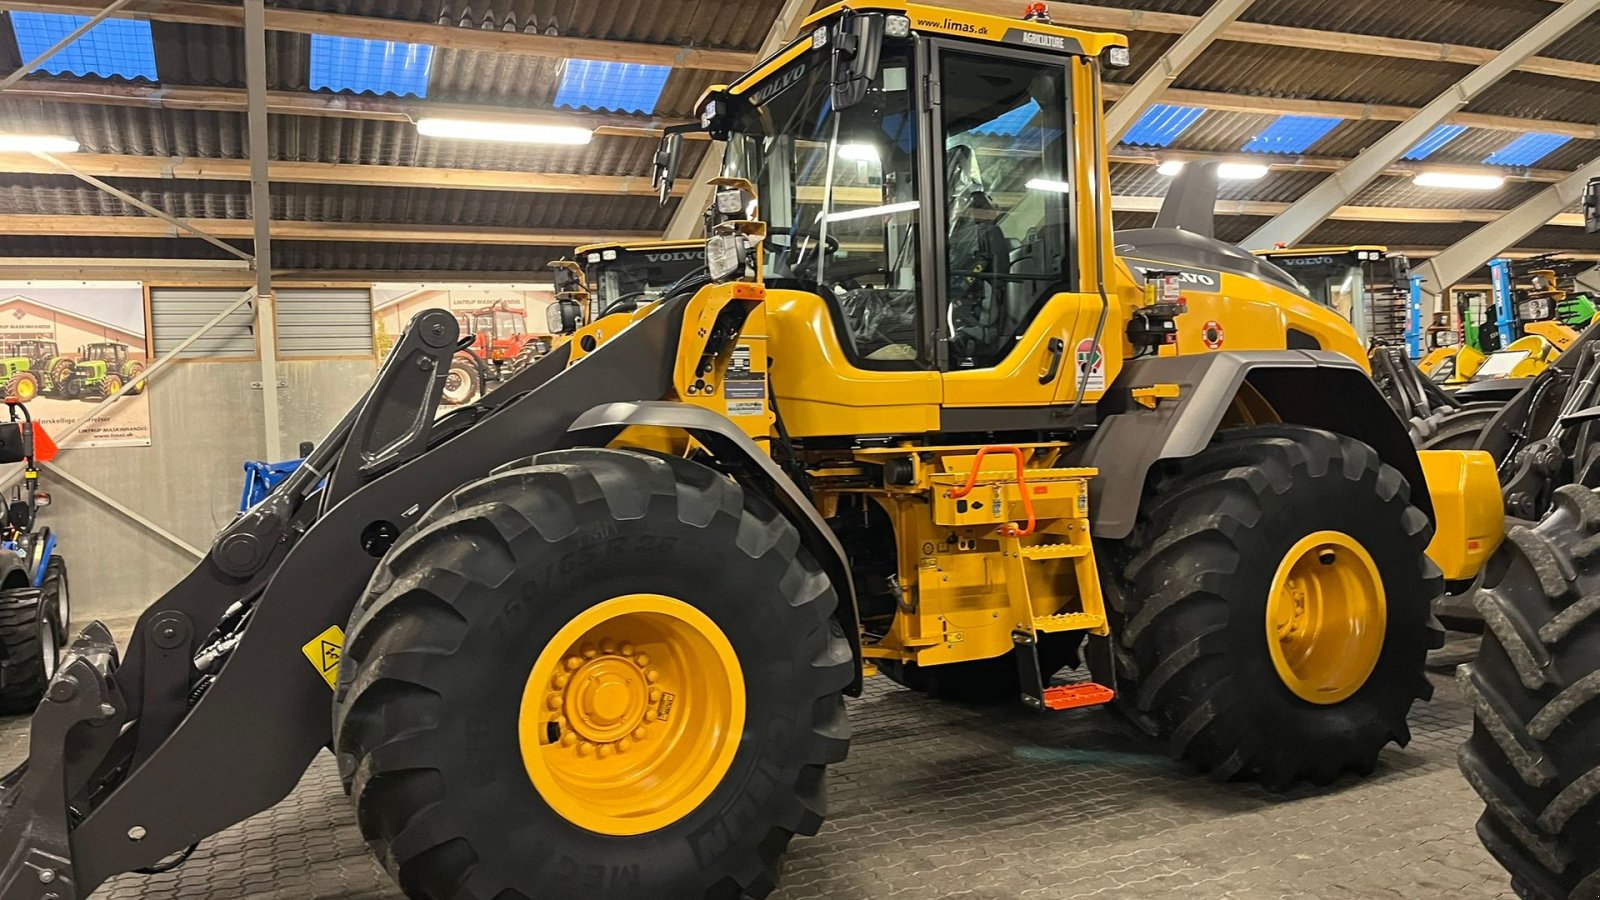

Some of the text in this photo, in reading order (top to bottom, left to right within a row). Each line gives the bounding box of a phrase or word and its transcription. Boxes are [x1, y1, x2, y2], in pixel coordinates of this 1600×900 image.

[917, 18, 989, 35] www.limas.dk
[1022, 31, 1065, 49] AGRICULTURE
[749, 63, 806, 105] VOLVO
[644, 251, 706, 263] VOLVO
[1283, 256, 1333, 266] VOLVO
